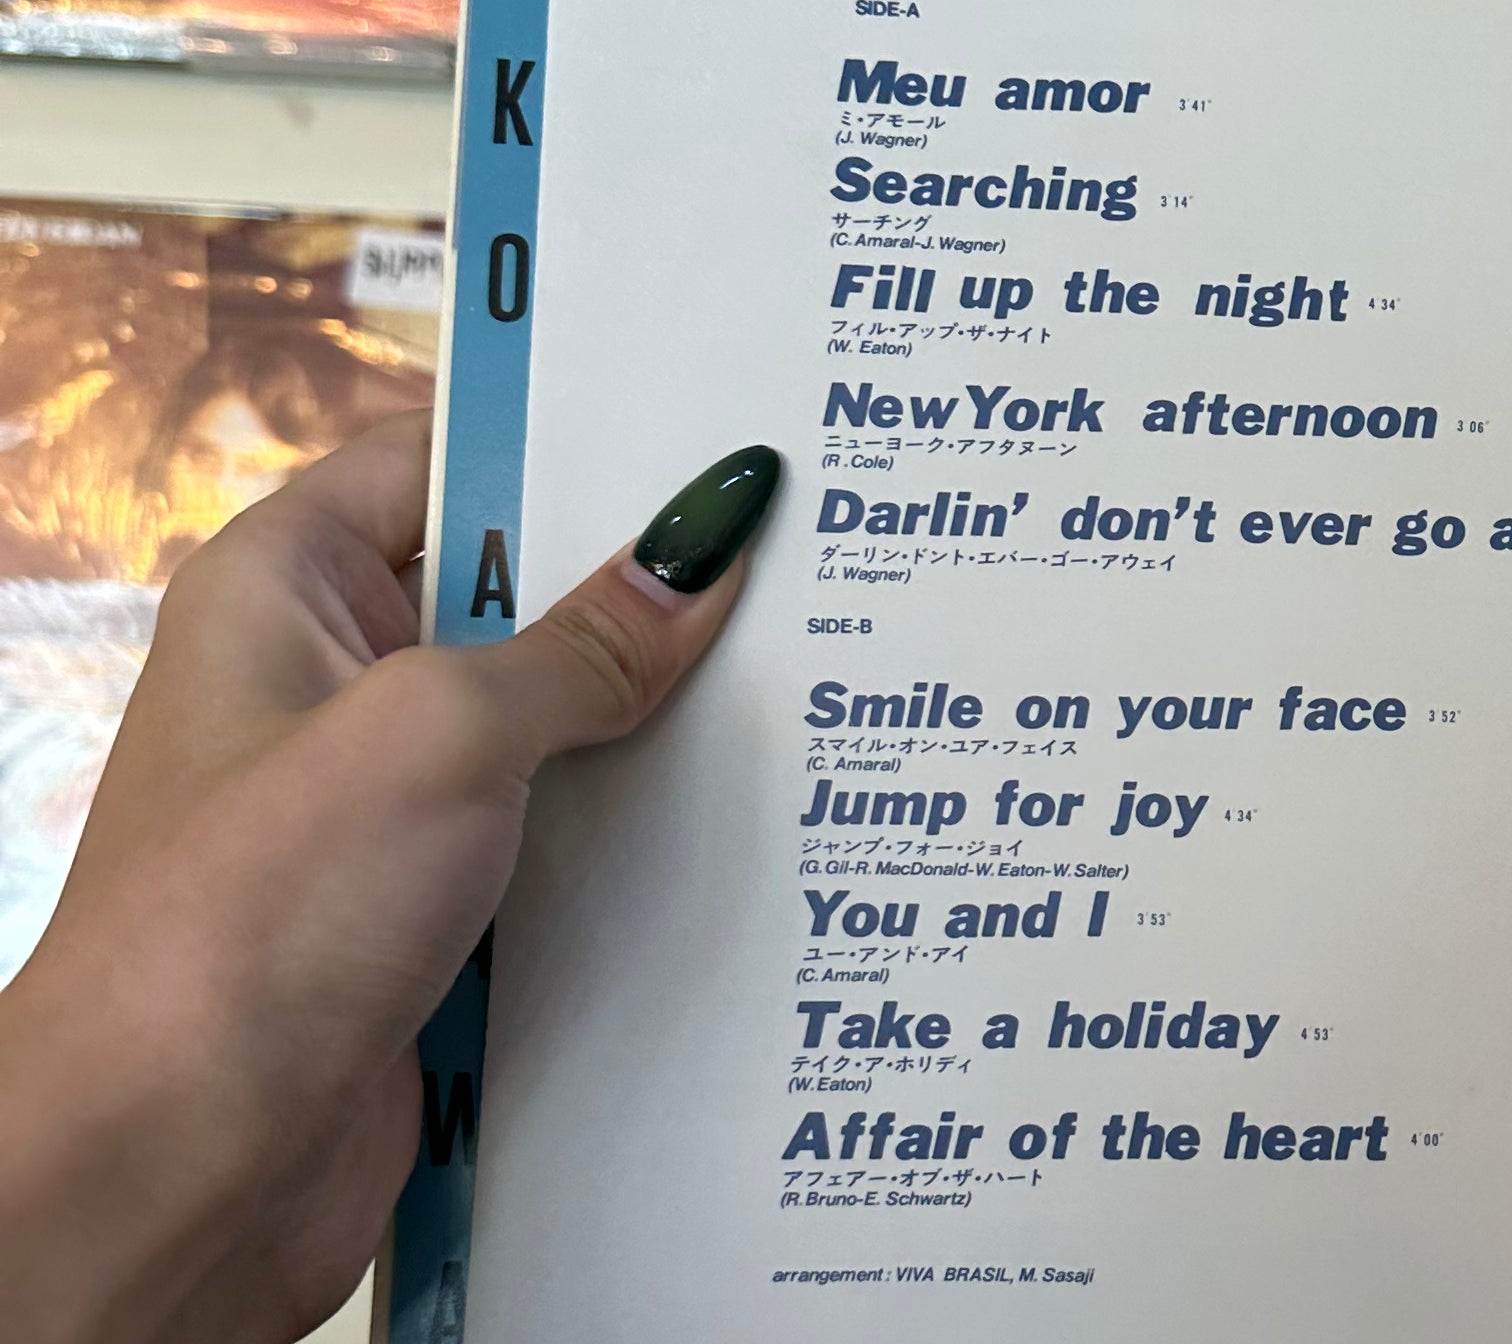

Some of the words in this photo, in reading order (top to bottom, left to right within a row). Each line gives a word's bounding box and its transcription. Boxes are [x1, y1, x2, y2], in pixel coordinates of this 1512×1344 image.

[855, 0, 920, 20] SIDE-A
[836, 58, 967, 108] Meu
[994, 77, 1151, 113] amor
[841, 110, 946, 129] ミ・アモール
[859, 131, 928, 150] Wagner)
[829, 156, 1138, 222] Searching
[831, 212, 934, 232] サーチング
[830, 263, 936, 313] Fill
[959, 276, 1034, 320] up
[1063, 268, 1160, 315] the
[1194, 273, 1349, 328] night
[857, 340, 912, 359] Eaton)
[1142, 391, 1438, 439] afternoon
[824, 435, 1077, 456] ニューヨーク・アフタヌーン
[816, 488, 1029, 538] Darlin'
[1060, 495, 1217, 543] don't
[1239, 511, 1373, 546] ever
[1392, 509, 1466, 556] go
[843, 566, 911, 584] Wagner)
[807, 617, 873, 635] SIDE-B
[803, 681, 983, 729] Smile
[1015, 695, 1090, 730] on
[1116, 696, 1253, 739] your
[1279, 686, 1407, 731] face
[832, 756, 902, 775] Amaral)
[799, 779, 967, 836] Jump
[995, 779, 1085, 827] for
[1110, 781, 1210, 838] joy
[802, 836, 1023, 858] ジャンプ・フォー・ジョイ
[803, 890, 920, 938] You
[943, 890, 1062, 939] and
[1087, 890, 1110, 937] I
[803, 945, 968, 964] ユー・アンド・アイ
[796, 1000, 952, 1050] Take
[981, 1014, 1020, 1050] a
[1047, 1000, 1281, 1059] holiday
[791, 1055, 972, 1074] テイク・ア・ホリディ
[780, 1111, 984, 1161] Affair
[1008, 1112, 1078, 1161] of
[1101, 1111, 1201, 1161] the
[1223, 1111, 1389, 1162] heart
[784, 1167, 1042, 1188] アフェアー・オブ・ザ・ハート
[896, 1266, 934, 1282] VIVA
[943, 1267, 1014, 1285] BRASIL,
[1041, 1267, 1095, 1285] Sasaji
